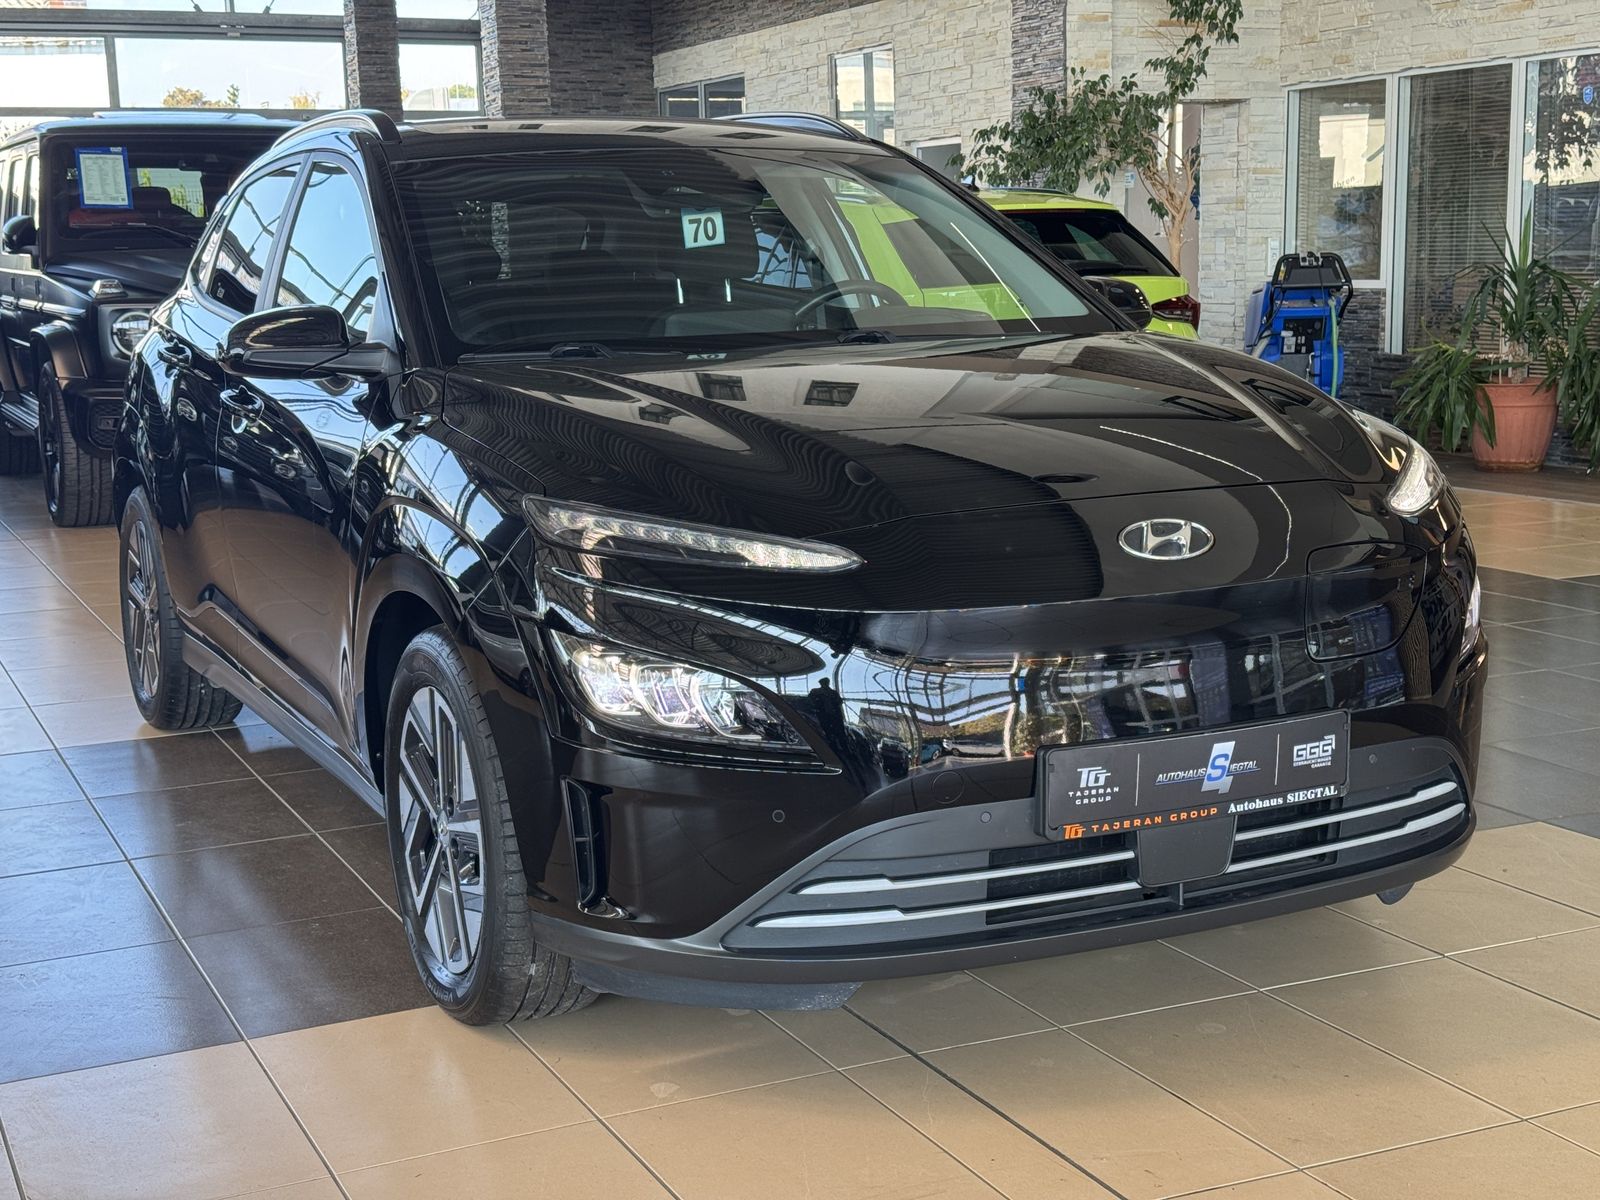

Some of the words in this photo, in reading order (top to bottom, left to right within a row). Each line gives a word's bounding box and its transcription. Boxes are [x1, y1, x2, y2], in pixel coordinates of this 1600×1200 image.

[688, 216, 717, 243] 70
[1293, 738, 1333, 762] GGG
[1156, 768, 1207, 783] AUTOHAUS
[1068, 786, 1120, 798] TAJERAN
[1075, 795, 1112, 805] GROUP
[1228, 796, 1284, 814] Autohaus
[1286, 785, 1338, 804] SIEGTAL
[1091, 815, 1162, 833] TAJERAN
[1169, 807, 1218, 822] GROUP
